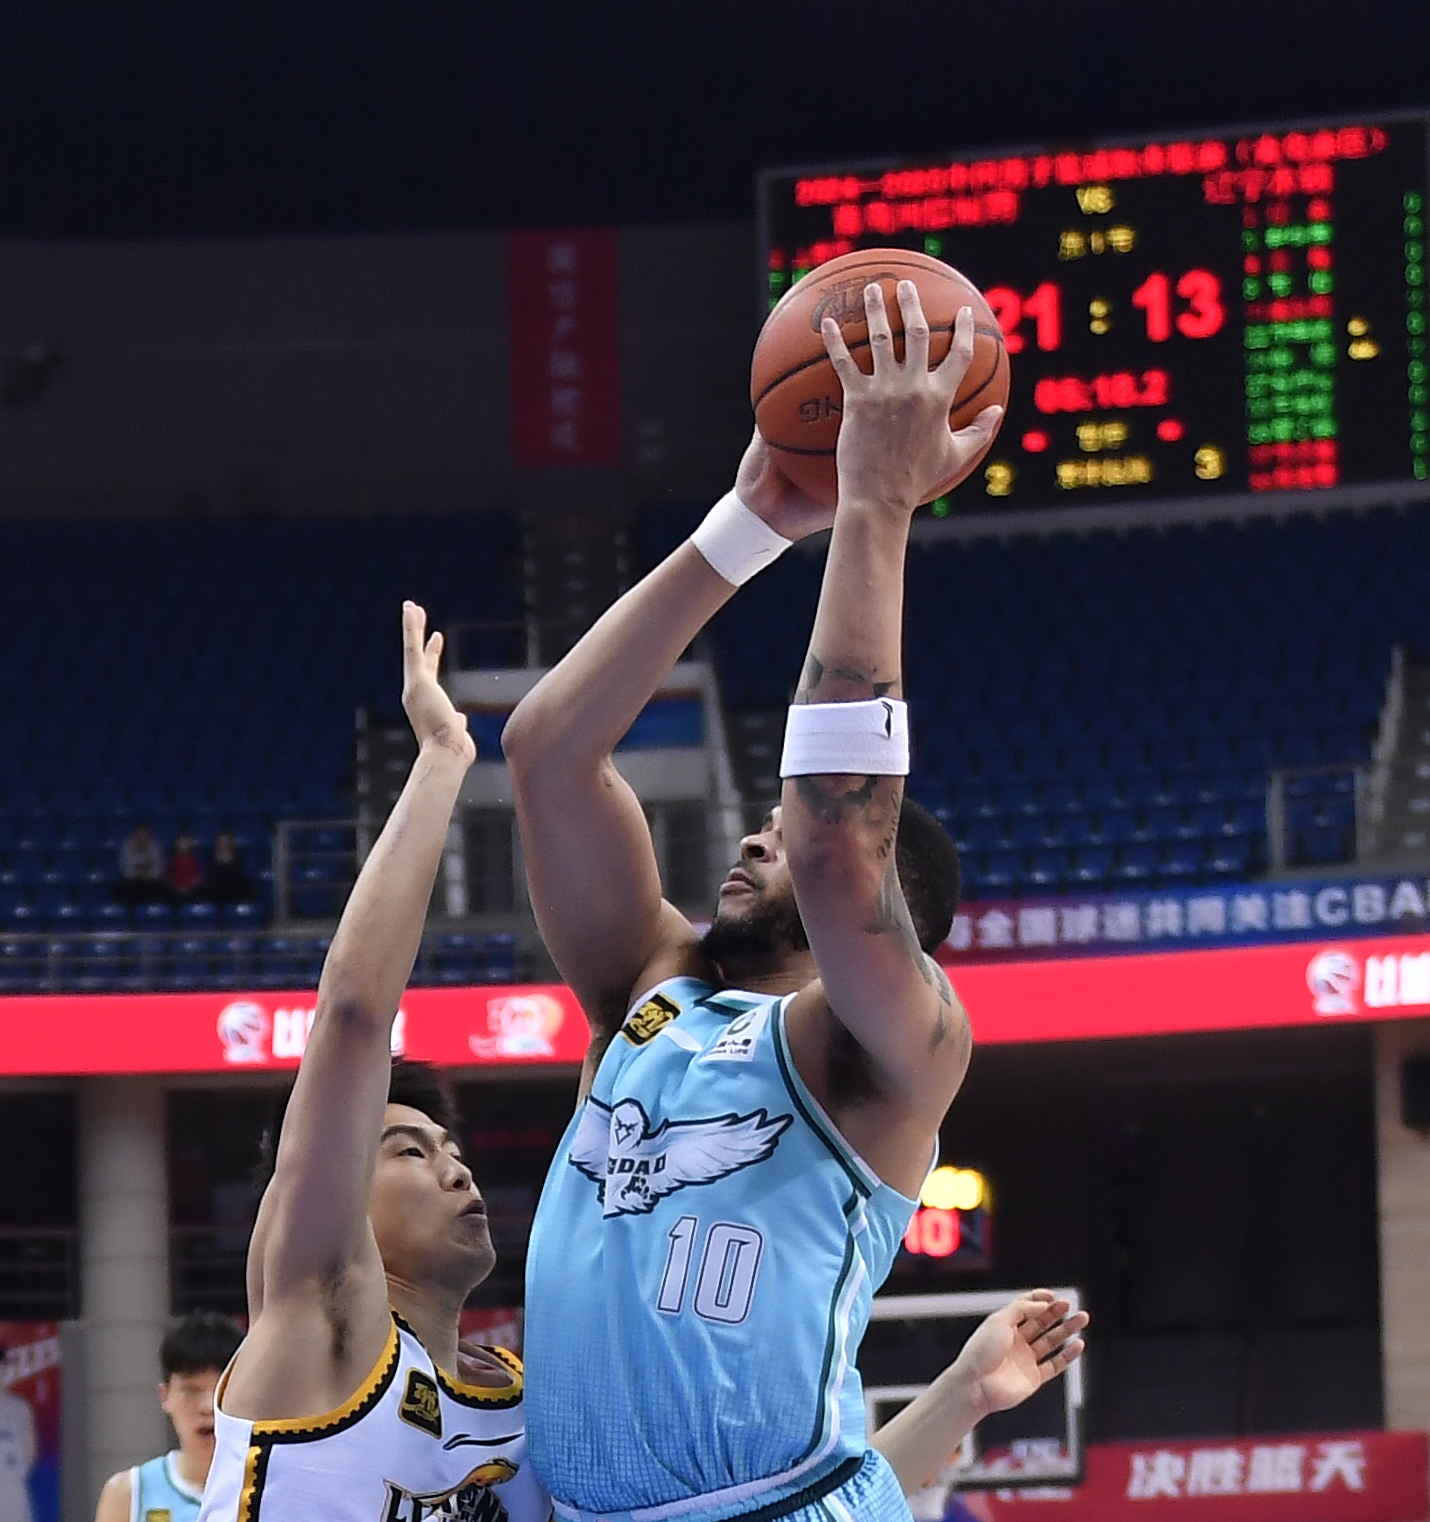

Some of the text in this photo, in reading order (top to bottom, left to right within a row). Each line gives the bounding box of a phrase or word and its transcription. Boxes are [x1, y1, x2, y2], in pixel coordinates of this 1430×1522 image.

[984, 269, 1226, 354] 21 13
[657, 1216, 764, 1325] 10
